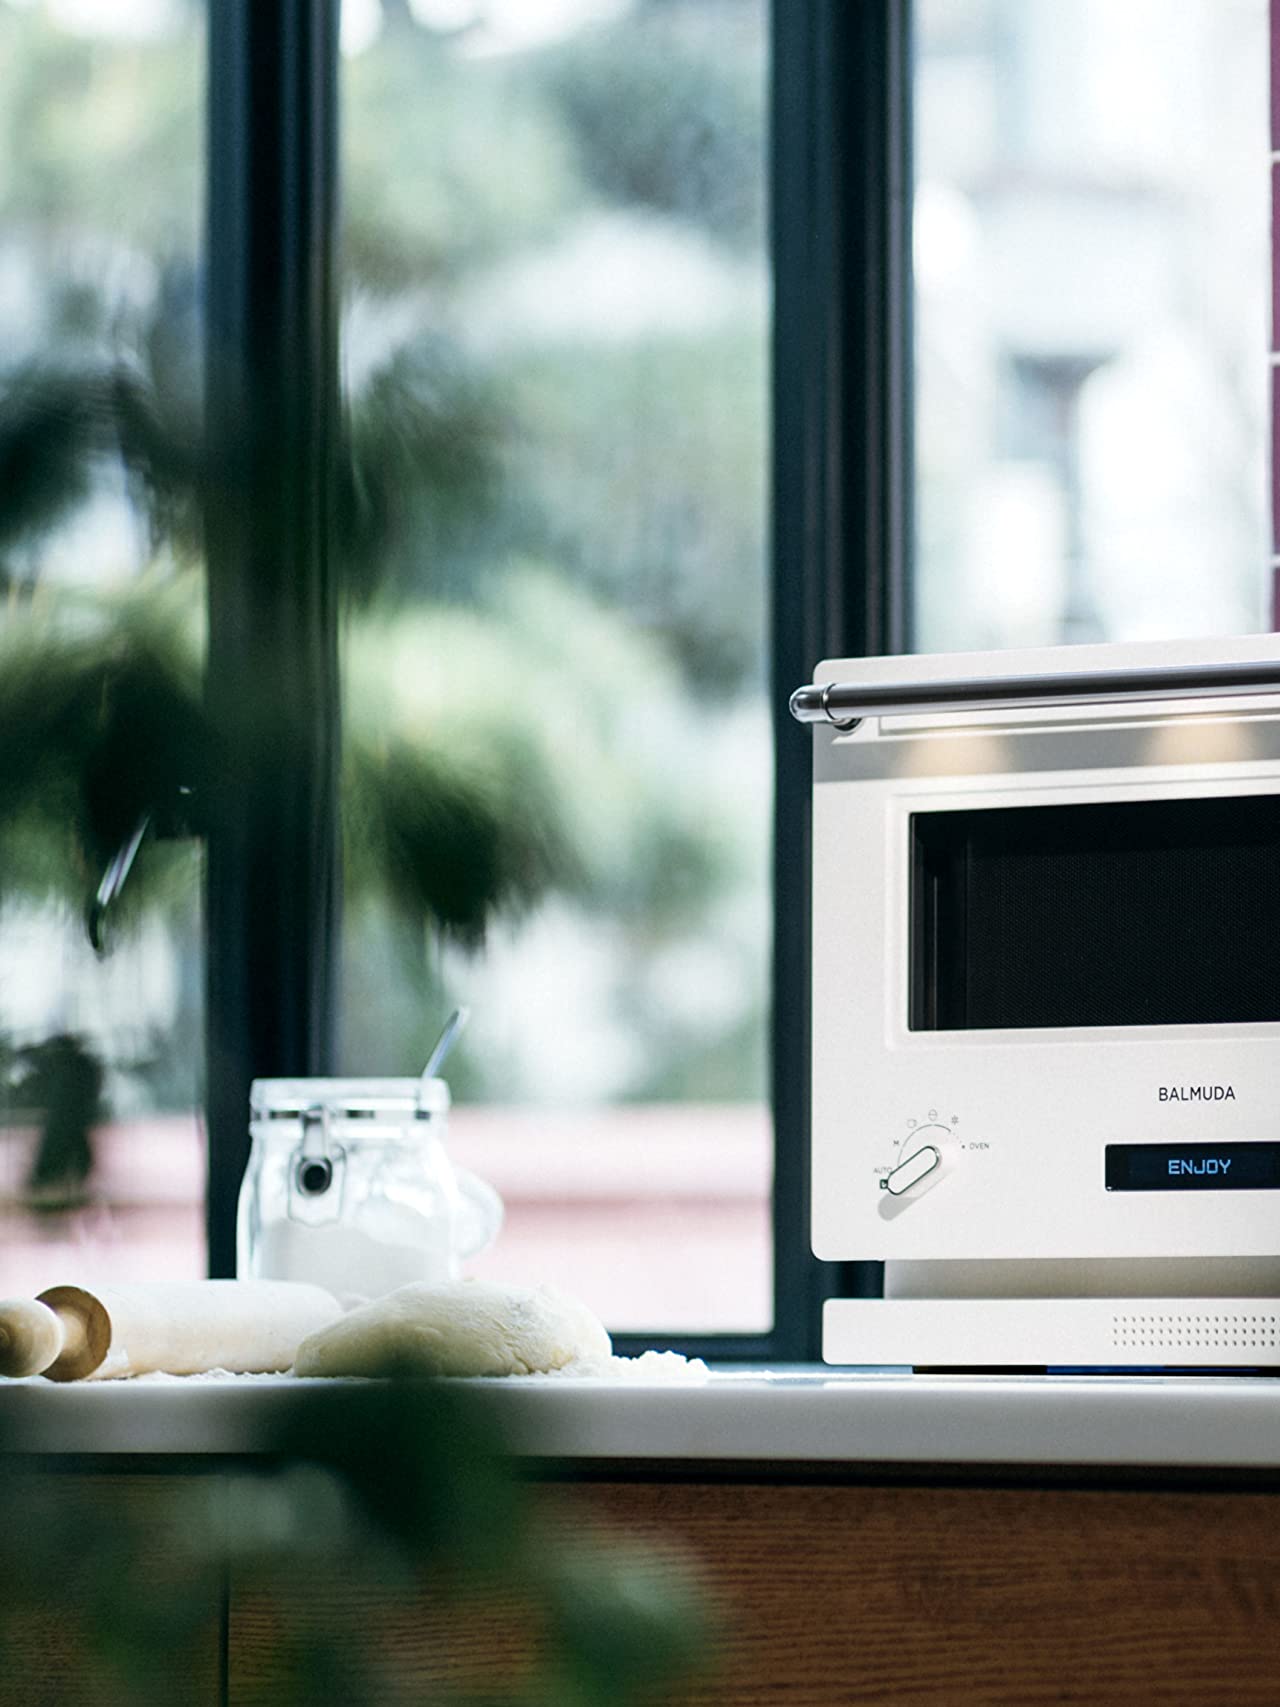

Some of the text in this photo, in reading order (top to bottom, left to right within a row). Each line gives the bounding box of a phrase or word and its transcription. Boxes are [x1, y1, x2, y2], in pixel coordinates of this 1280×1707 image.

[1158, 1086, 1236, 1101] BALMUDA
[969, 1142, 990, 1150] OVEN
[873, 1167, 893, 1175] AUTO
[1168, 1159, 1231, 1175] ENJOY
